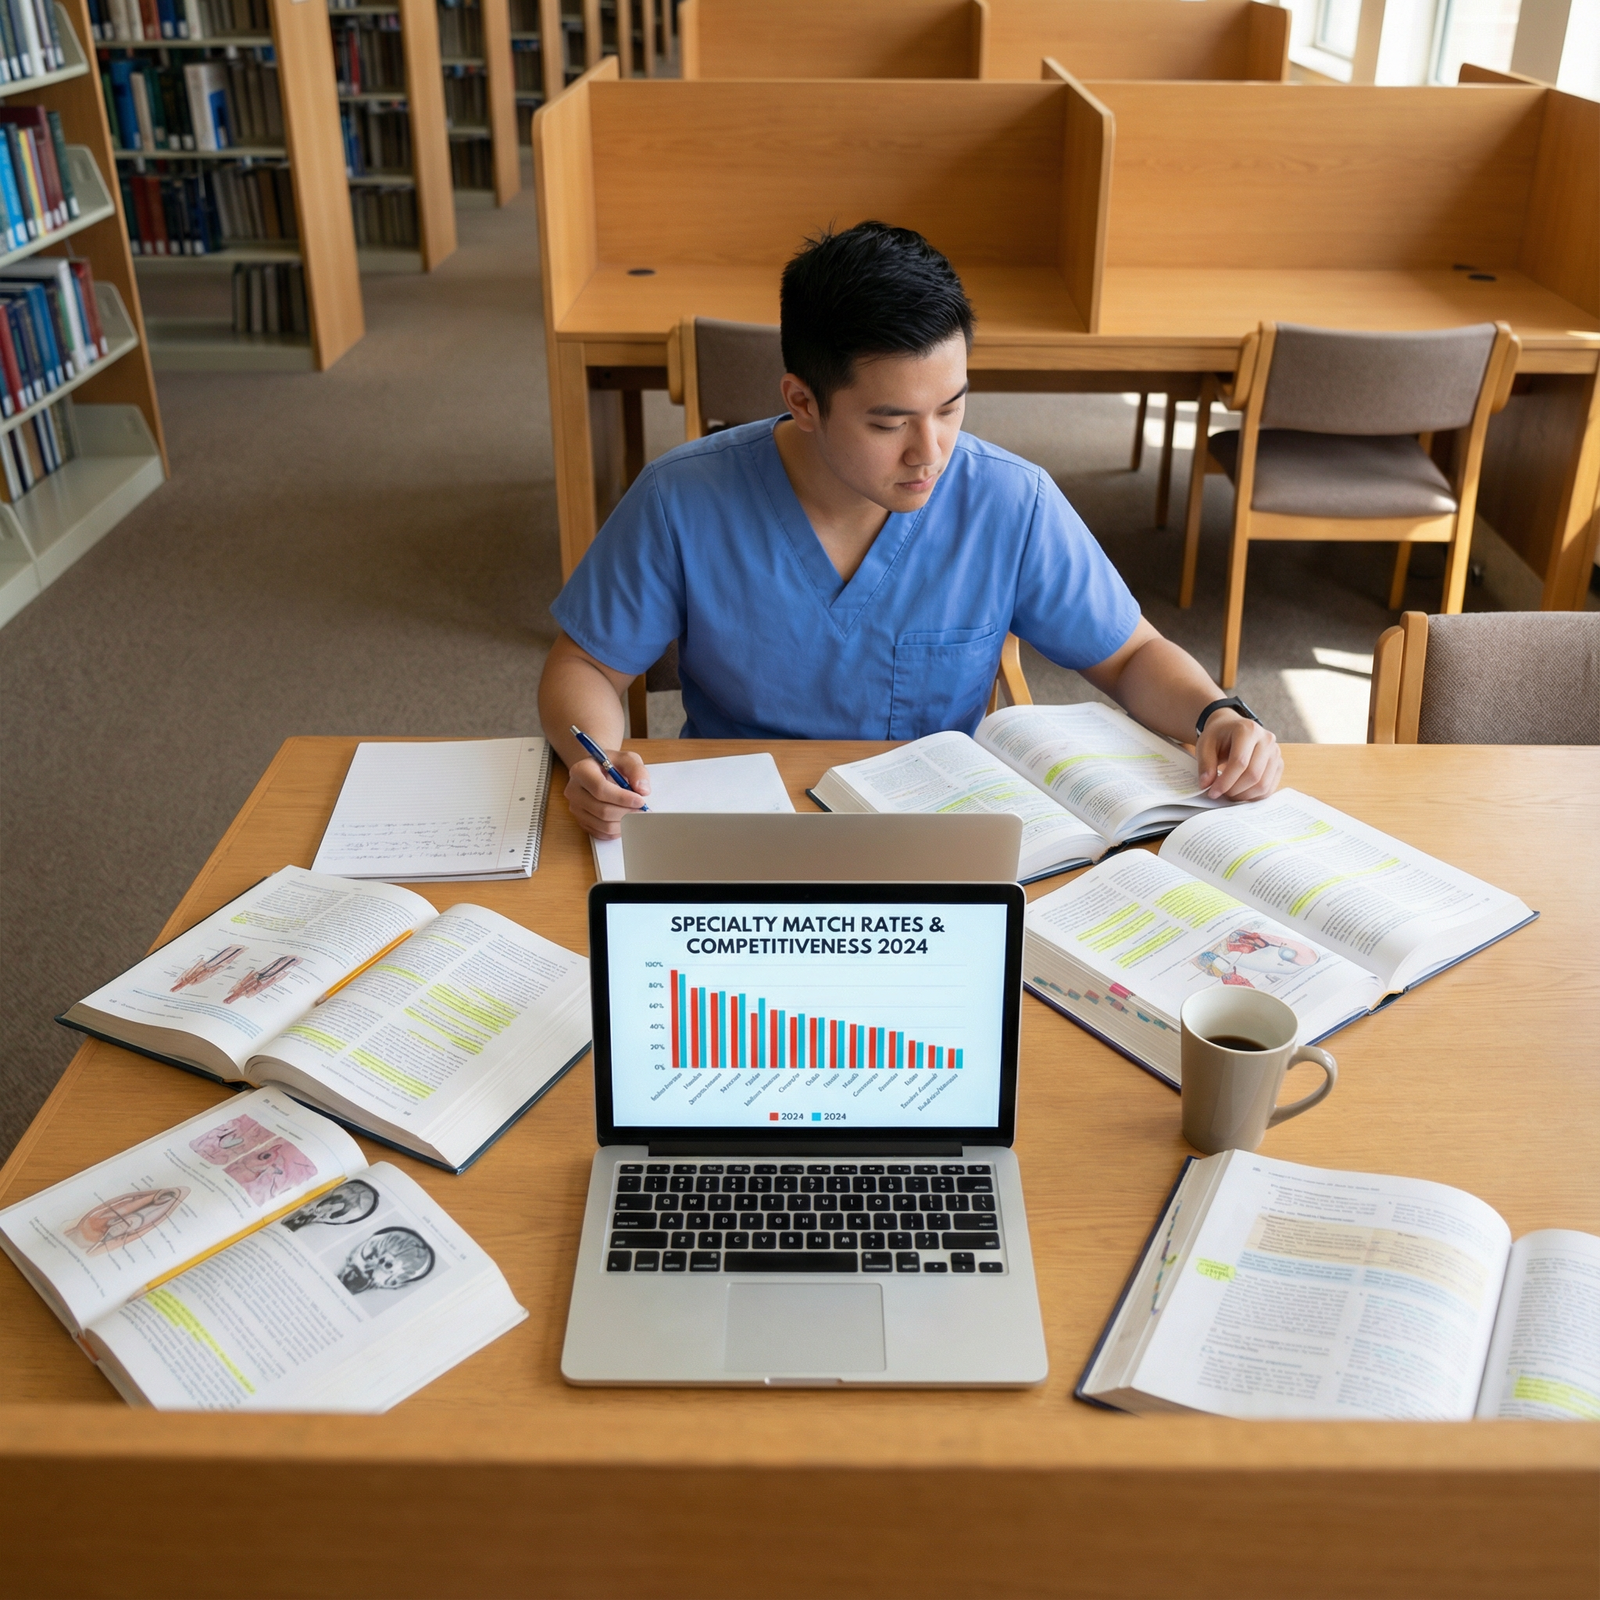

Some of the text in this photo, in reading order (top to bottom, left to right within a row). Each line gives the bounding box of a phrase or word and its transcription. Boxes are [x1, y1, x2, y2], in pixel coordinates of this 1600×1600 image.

[671, 916, 945, 932] SPECIALTY MATCH RATES &
[687, 938, 928, 954] COMPETITIVENESS 2024
